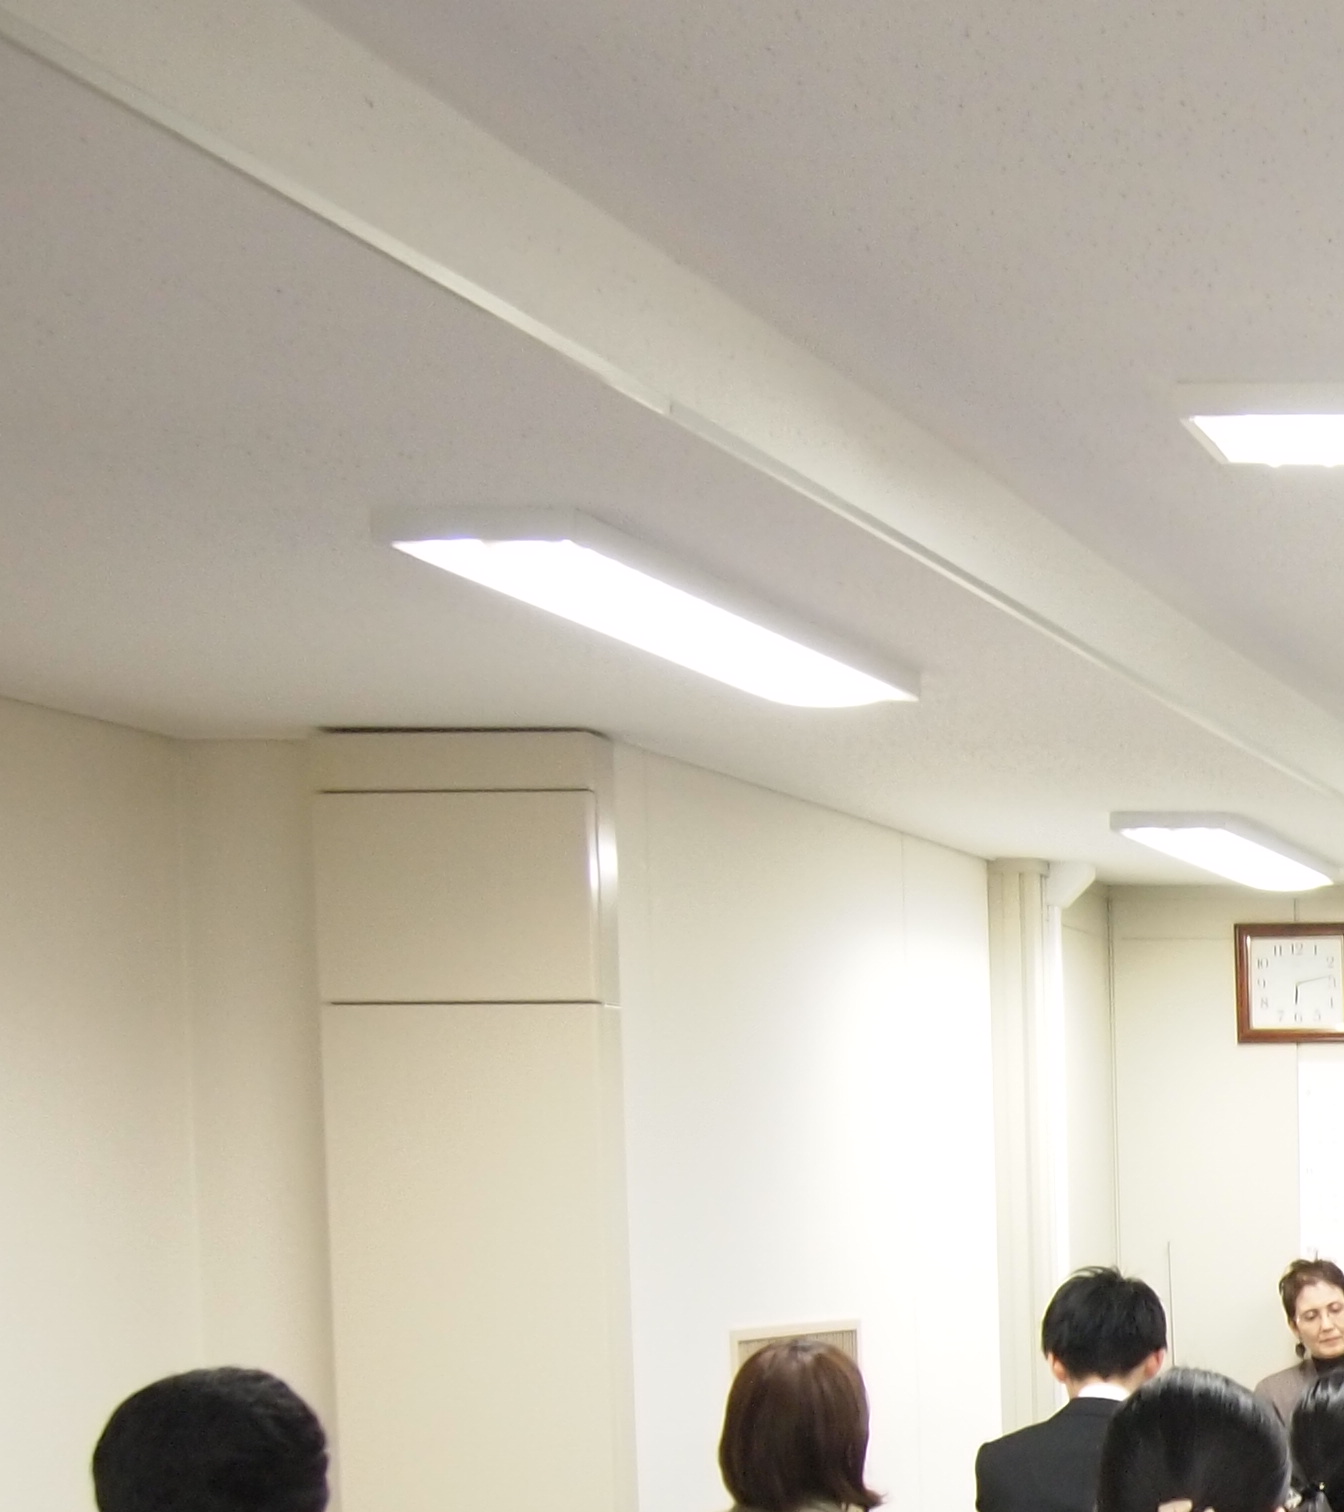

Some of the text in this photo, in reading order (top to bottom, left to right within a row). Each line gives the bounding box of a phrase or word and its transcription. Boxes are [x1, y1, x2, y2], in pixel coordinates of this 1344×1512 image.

[1273, 945, 1283, 956] 11
[1291, 943, 1304, 956] 12
[1257, 957, 1269, 969] 10
[1326, 956, 1335, 969] 2
